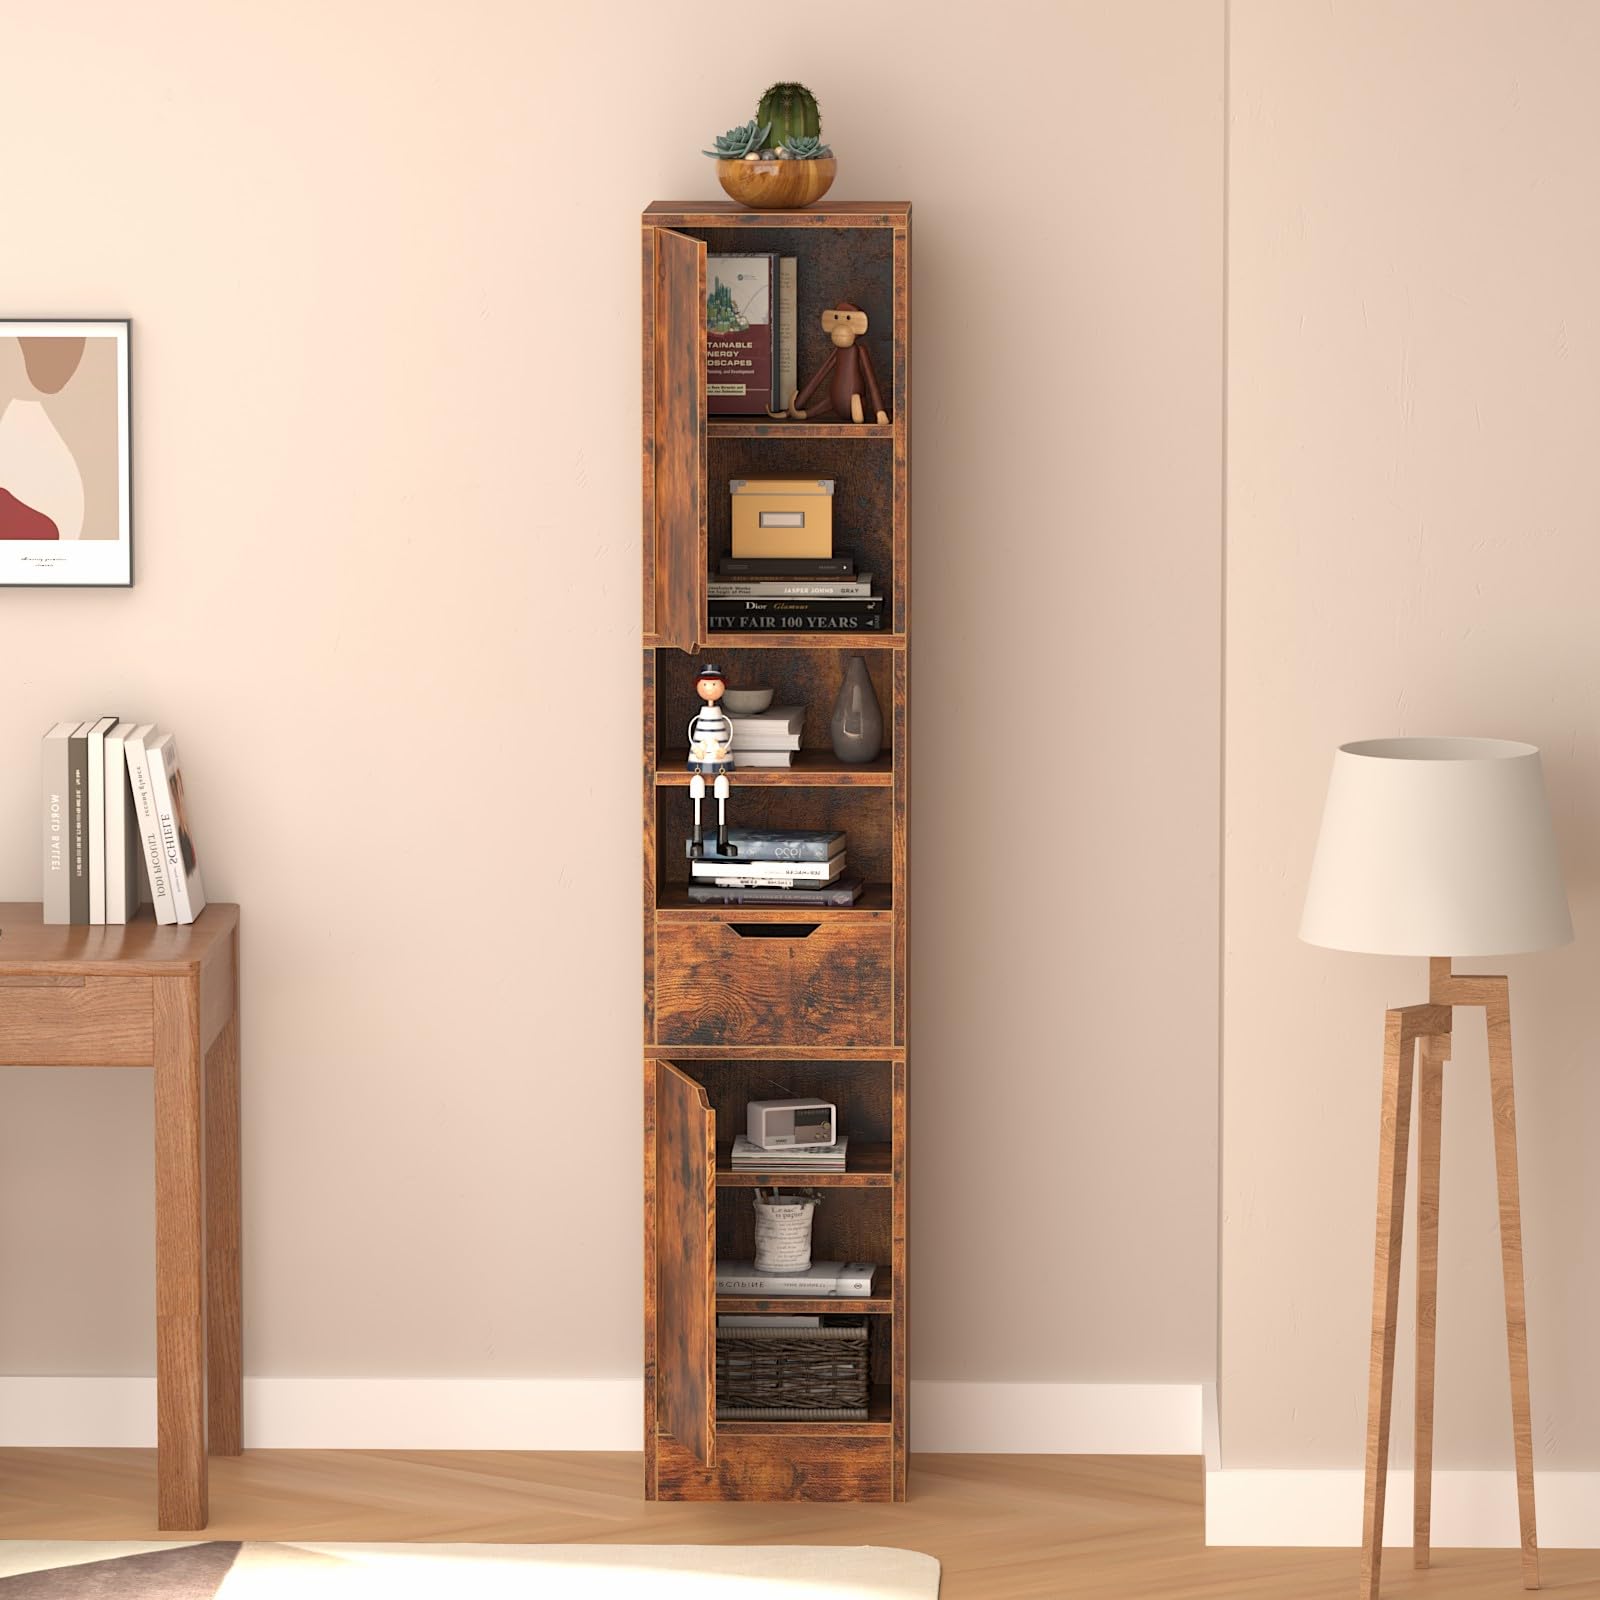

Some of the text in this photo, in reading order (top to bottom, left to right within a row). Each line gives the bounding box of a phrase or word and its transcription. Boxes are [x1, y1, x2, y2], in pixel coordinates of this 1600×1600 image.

[745, 601, 768, 610] Dior
[740, 616, 776, 628] FAIR
[781, 616, 802, 628] 100
[806, 616, 858, 628] YEARS
